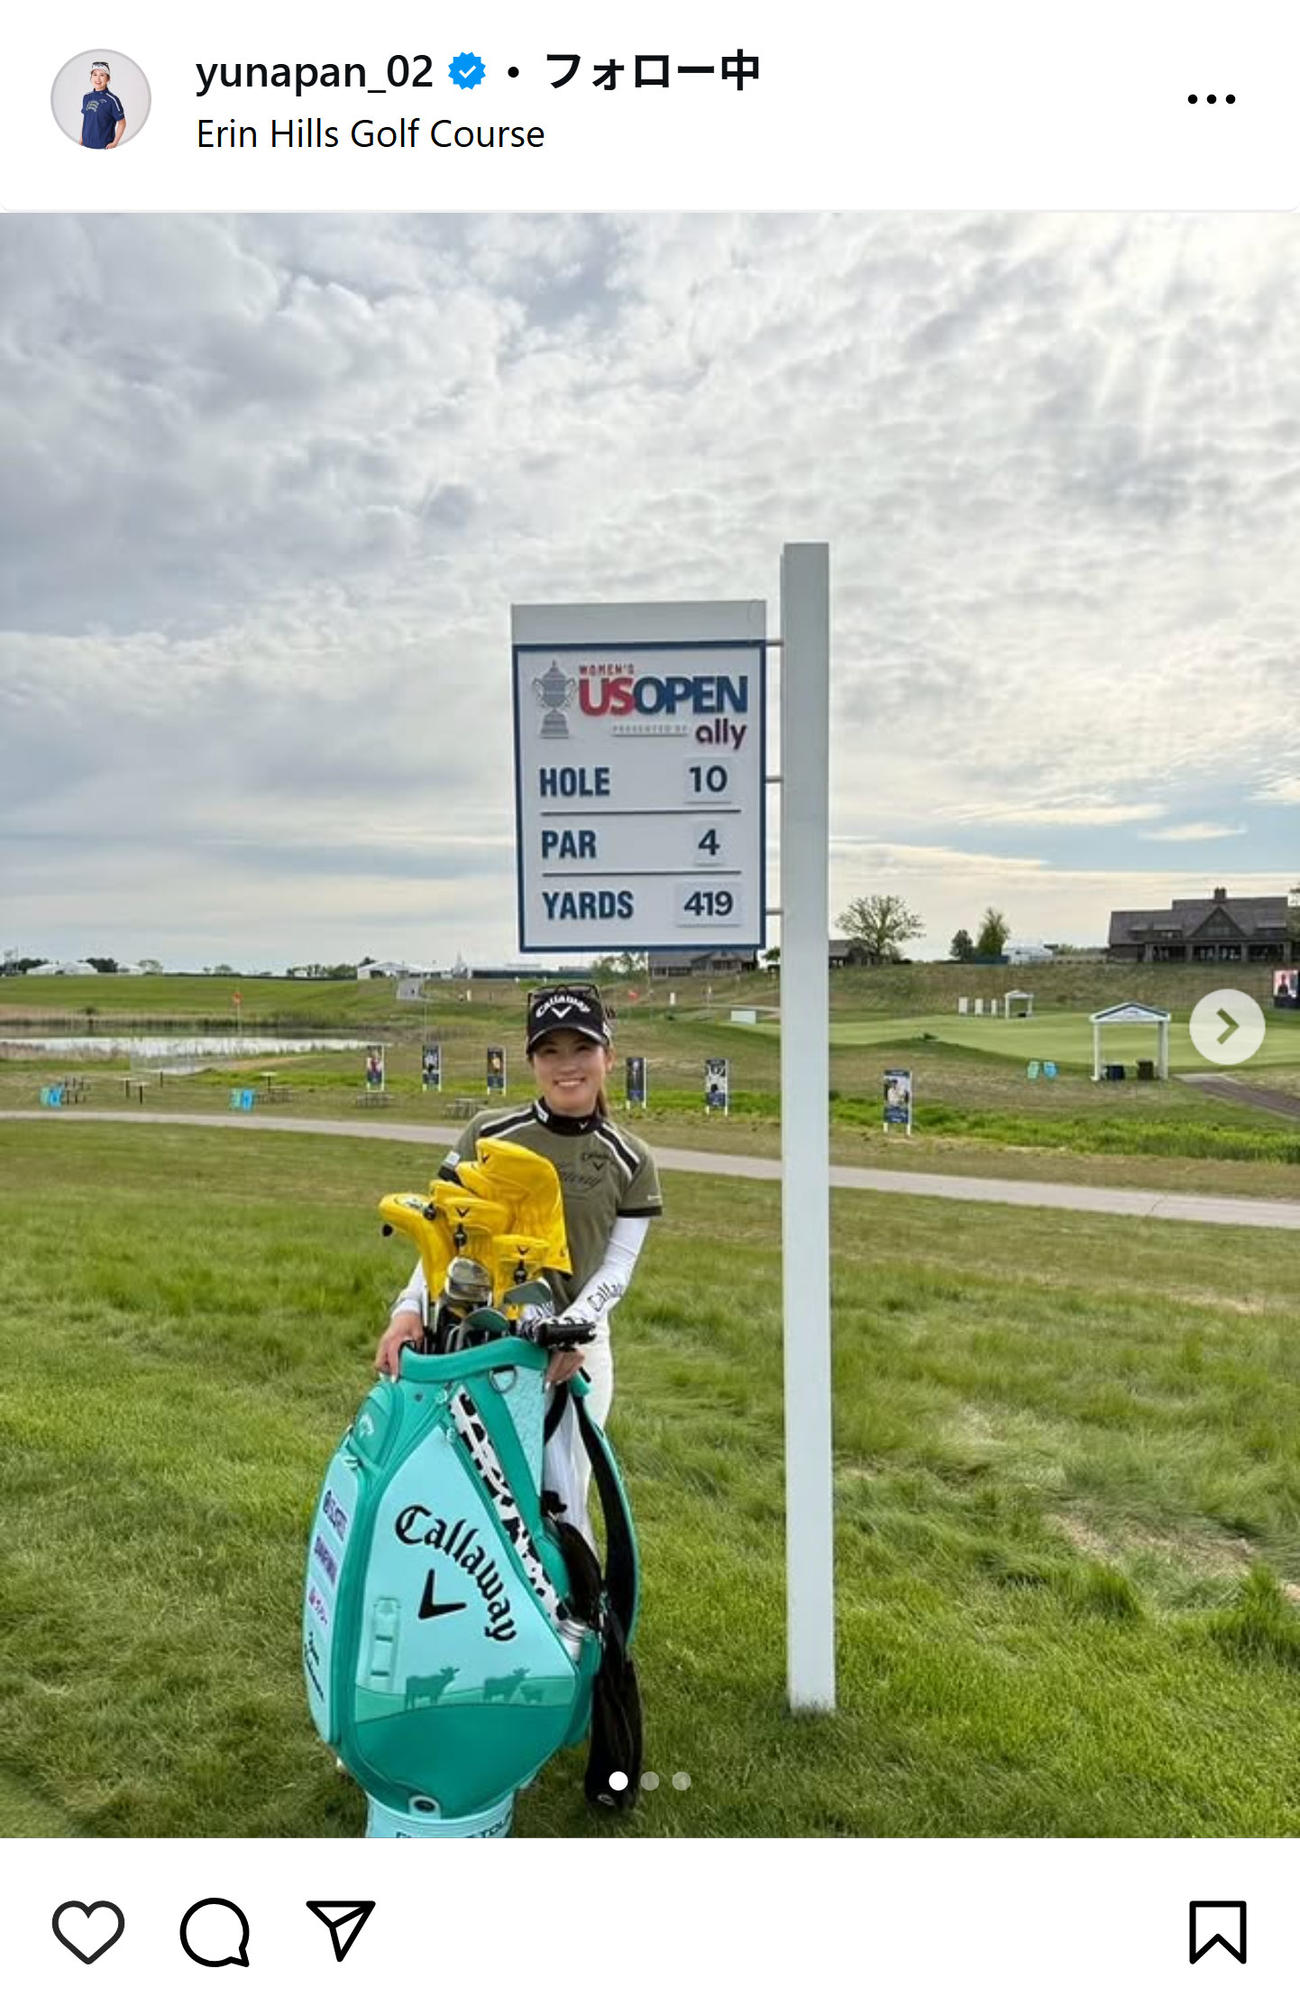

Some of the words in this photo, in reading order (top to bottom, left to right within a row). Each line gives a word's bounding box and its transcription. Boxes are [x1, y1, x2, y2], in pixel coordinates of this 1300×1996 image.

[579, 664, 635, 676] WOMEN'S
[695, 718, 747, 750] ally
[539, 766, 611, 798] HOLE
[688, 765, 728, 793] 10
[541, 829, 597, 860] PAR
[697, 828, 720, 857] 4
[541, 890, 635, 921] YARDS
[683, 890, 734, 918] 419
[535, 994, 592, 1018] Callaway
[395, 1504, 517, 1642] Callaway
